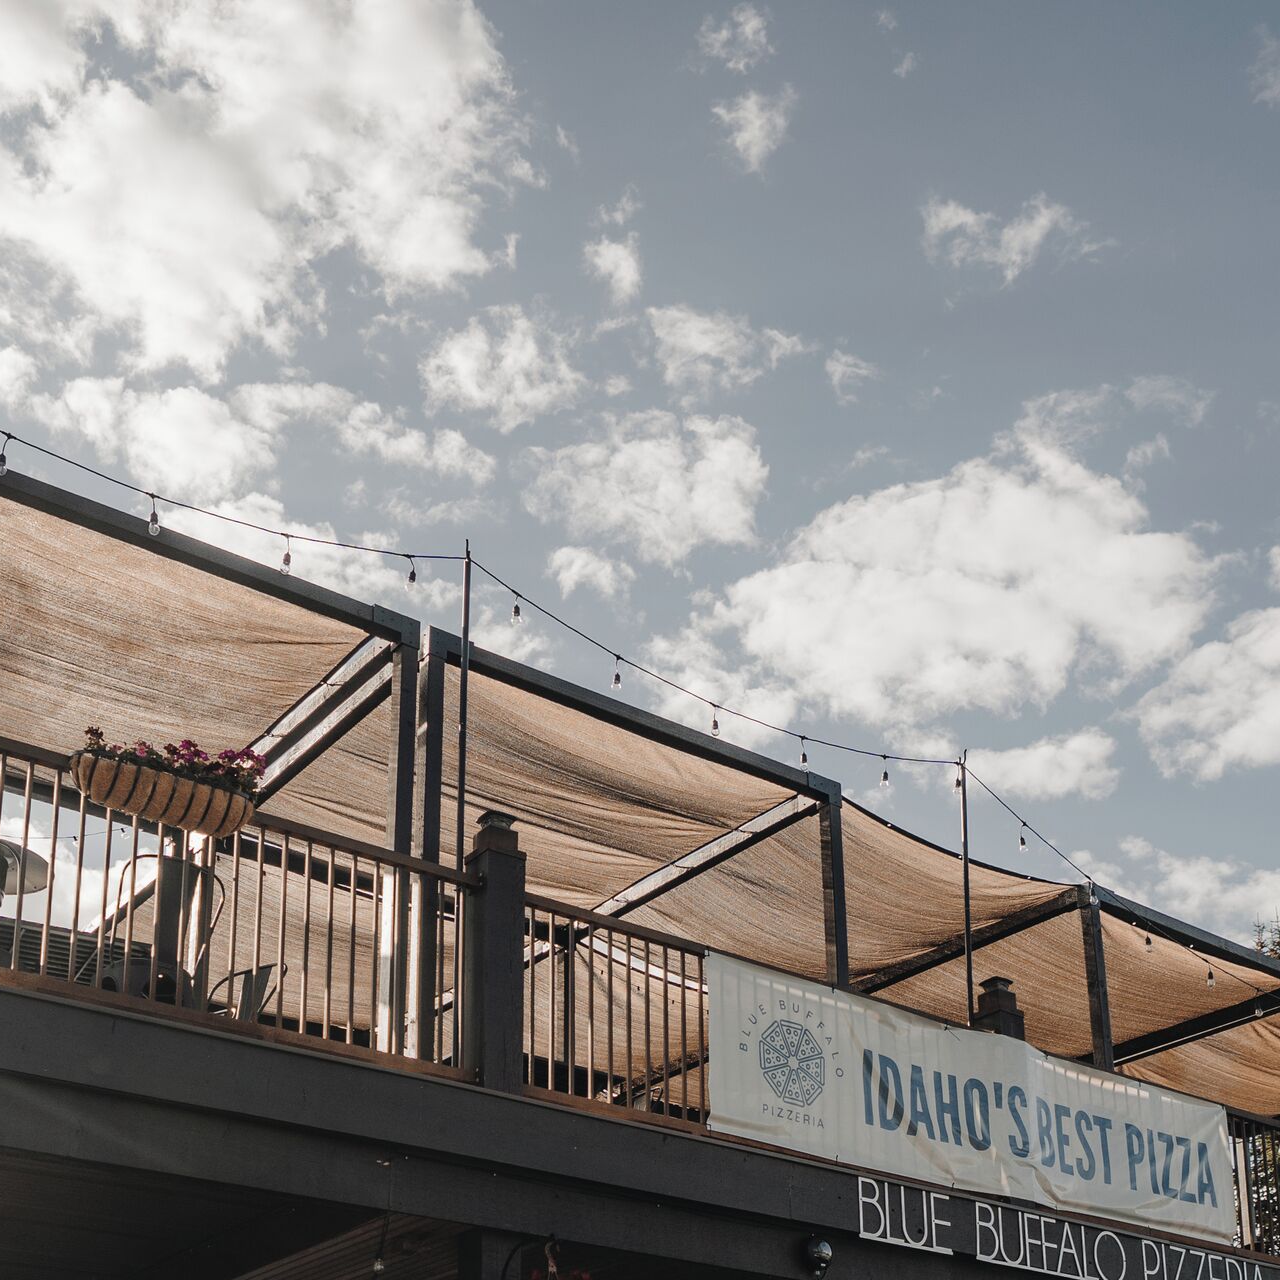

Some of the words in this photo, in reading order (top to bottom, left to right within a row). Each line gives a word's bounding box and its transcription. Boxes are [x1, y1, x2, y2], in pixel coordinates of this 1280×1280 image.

[739, 1004, 767, 1052] BLUE
[779, 1000, 844, 1078] BUFFALO
[762, 1103, 825, 1129] PIZZERIA
[863, 1048, 1030, 1158] IDAHO'S
[1036, 1096, 1112, 1185] BEST
[1125, 1122, 1218, 1208] PIZZA
[858, 1176, 954, 1256] BLUE
